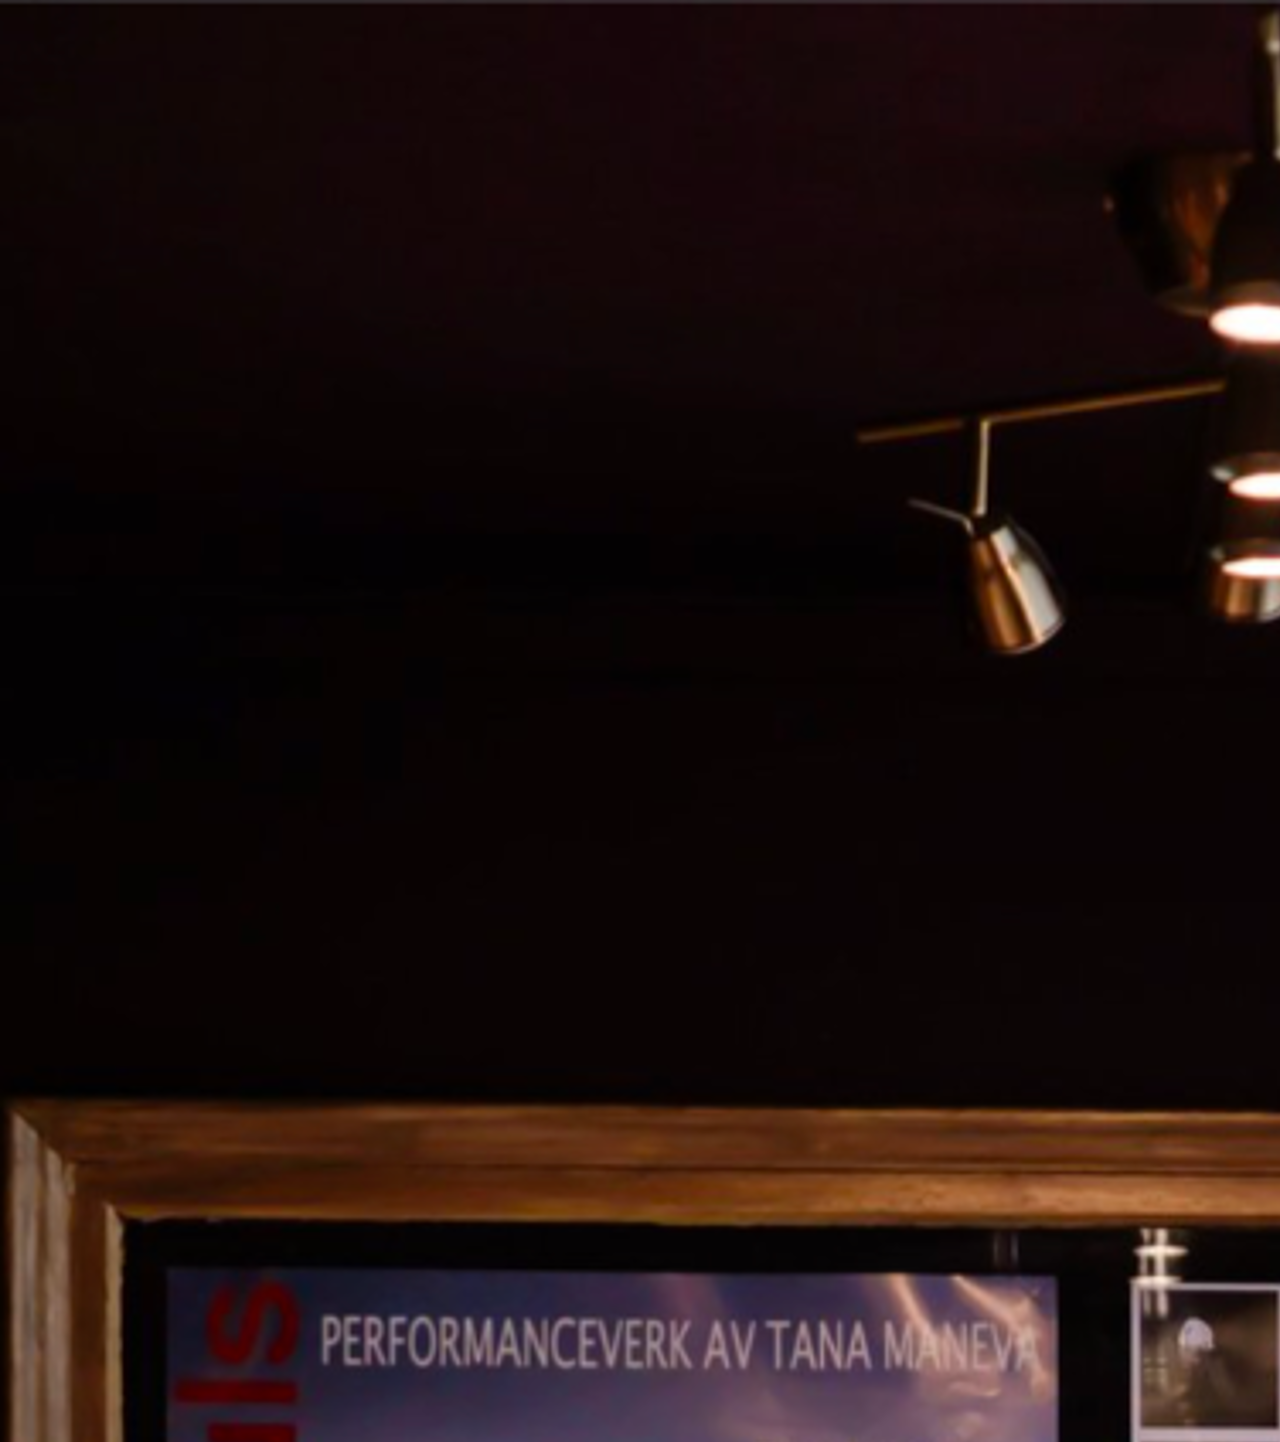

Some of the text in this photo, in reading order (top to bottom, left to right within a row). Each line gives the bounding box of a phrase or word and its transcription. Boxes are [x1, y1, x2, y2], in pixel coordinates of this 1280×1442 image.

[321, 1315, 1040, 1373] PERFORMANCEVERK AV TANA MANEVA
